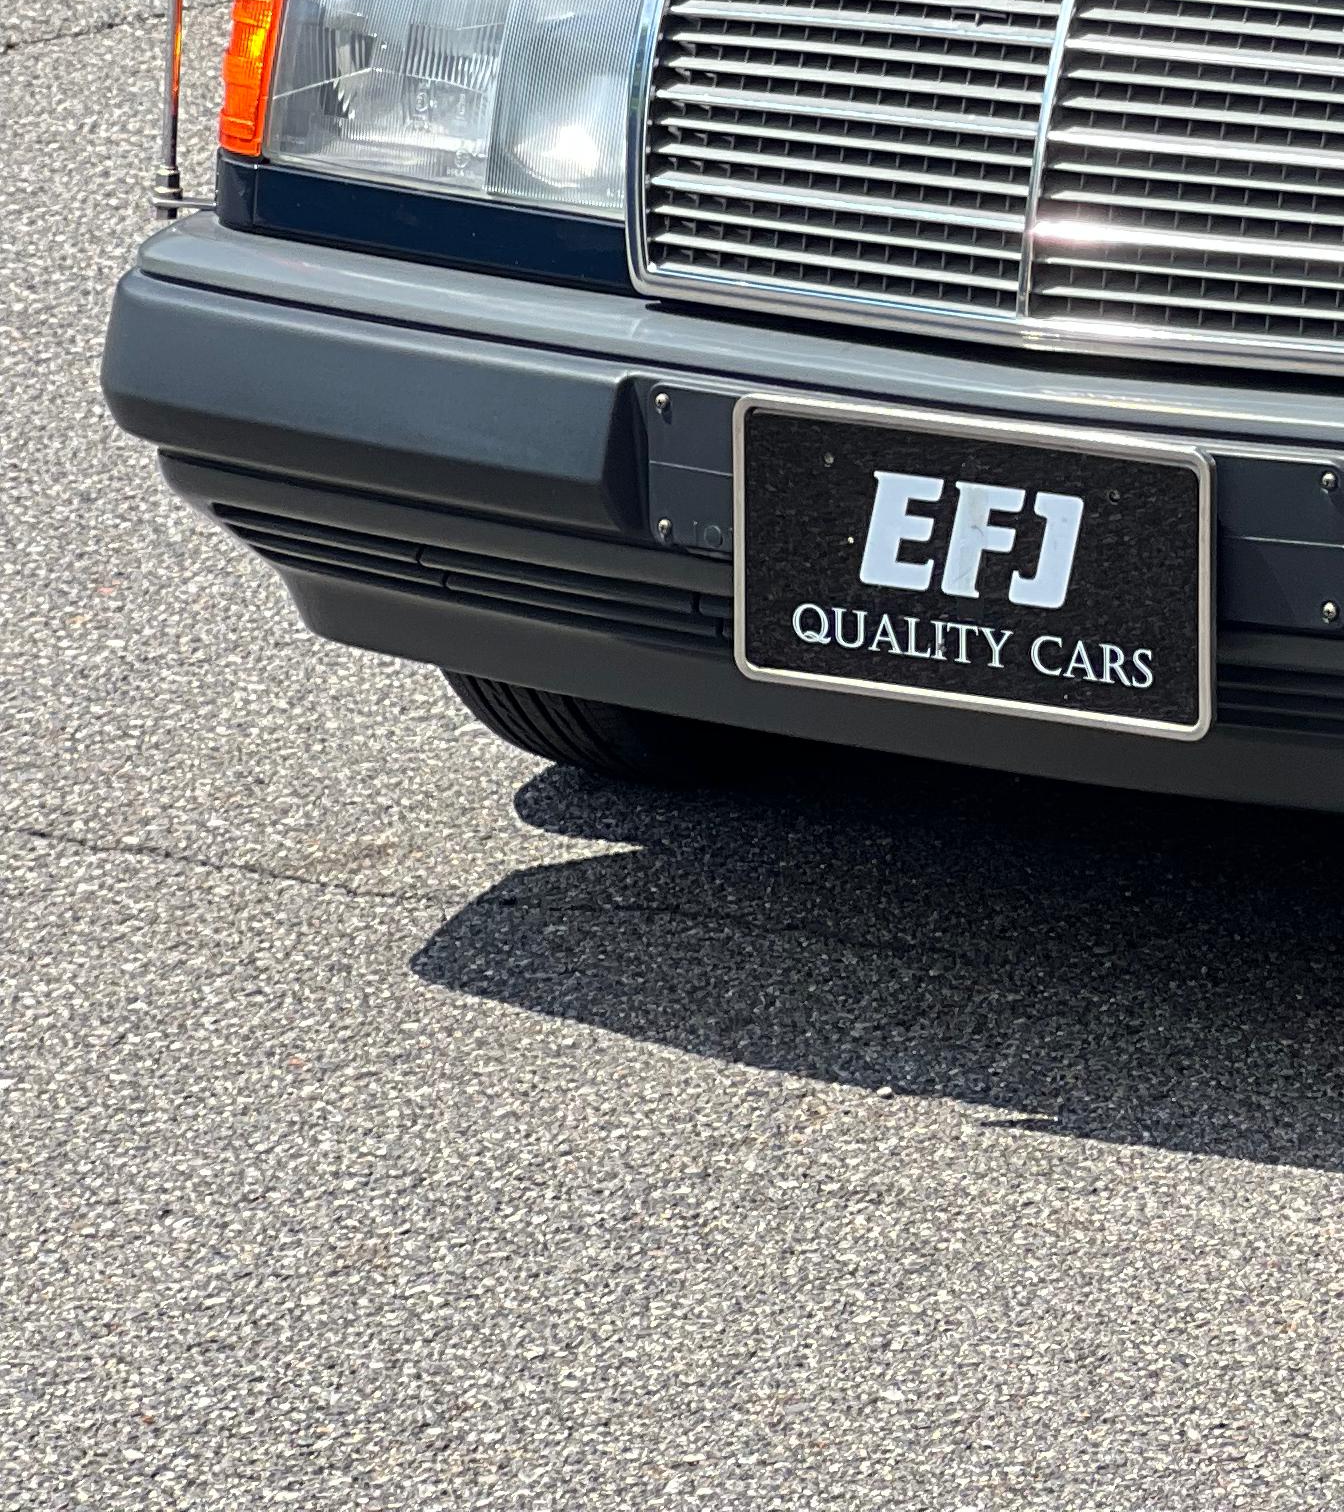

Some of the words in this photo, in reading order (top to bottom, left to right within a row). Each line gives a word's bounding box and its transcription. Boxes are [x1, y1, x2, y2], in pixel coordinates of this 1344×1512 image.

[859, 469, 1084, 610] EFJ
[791, 602, 1015, 670] QUALITY
[1030, 634, 1155, 690] CARS
